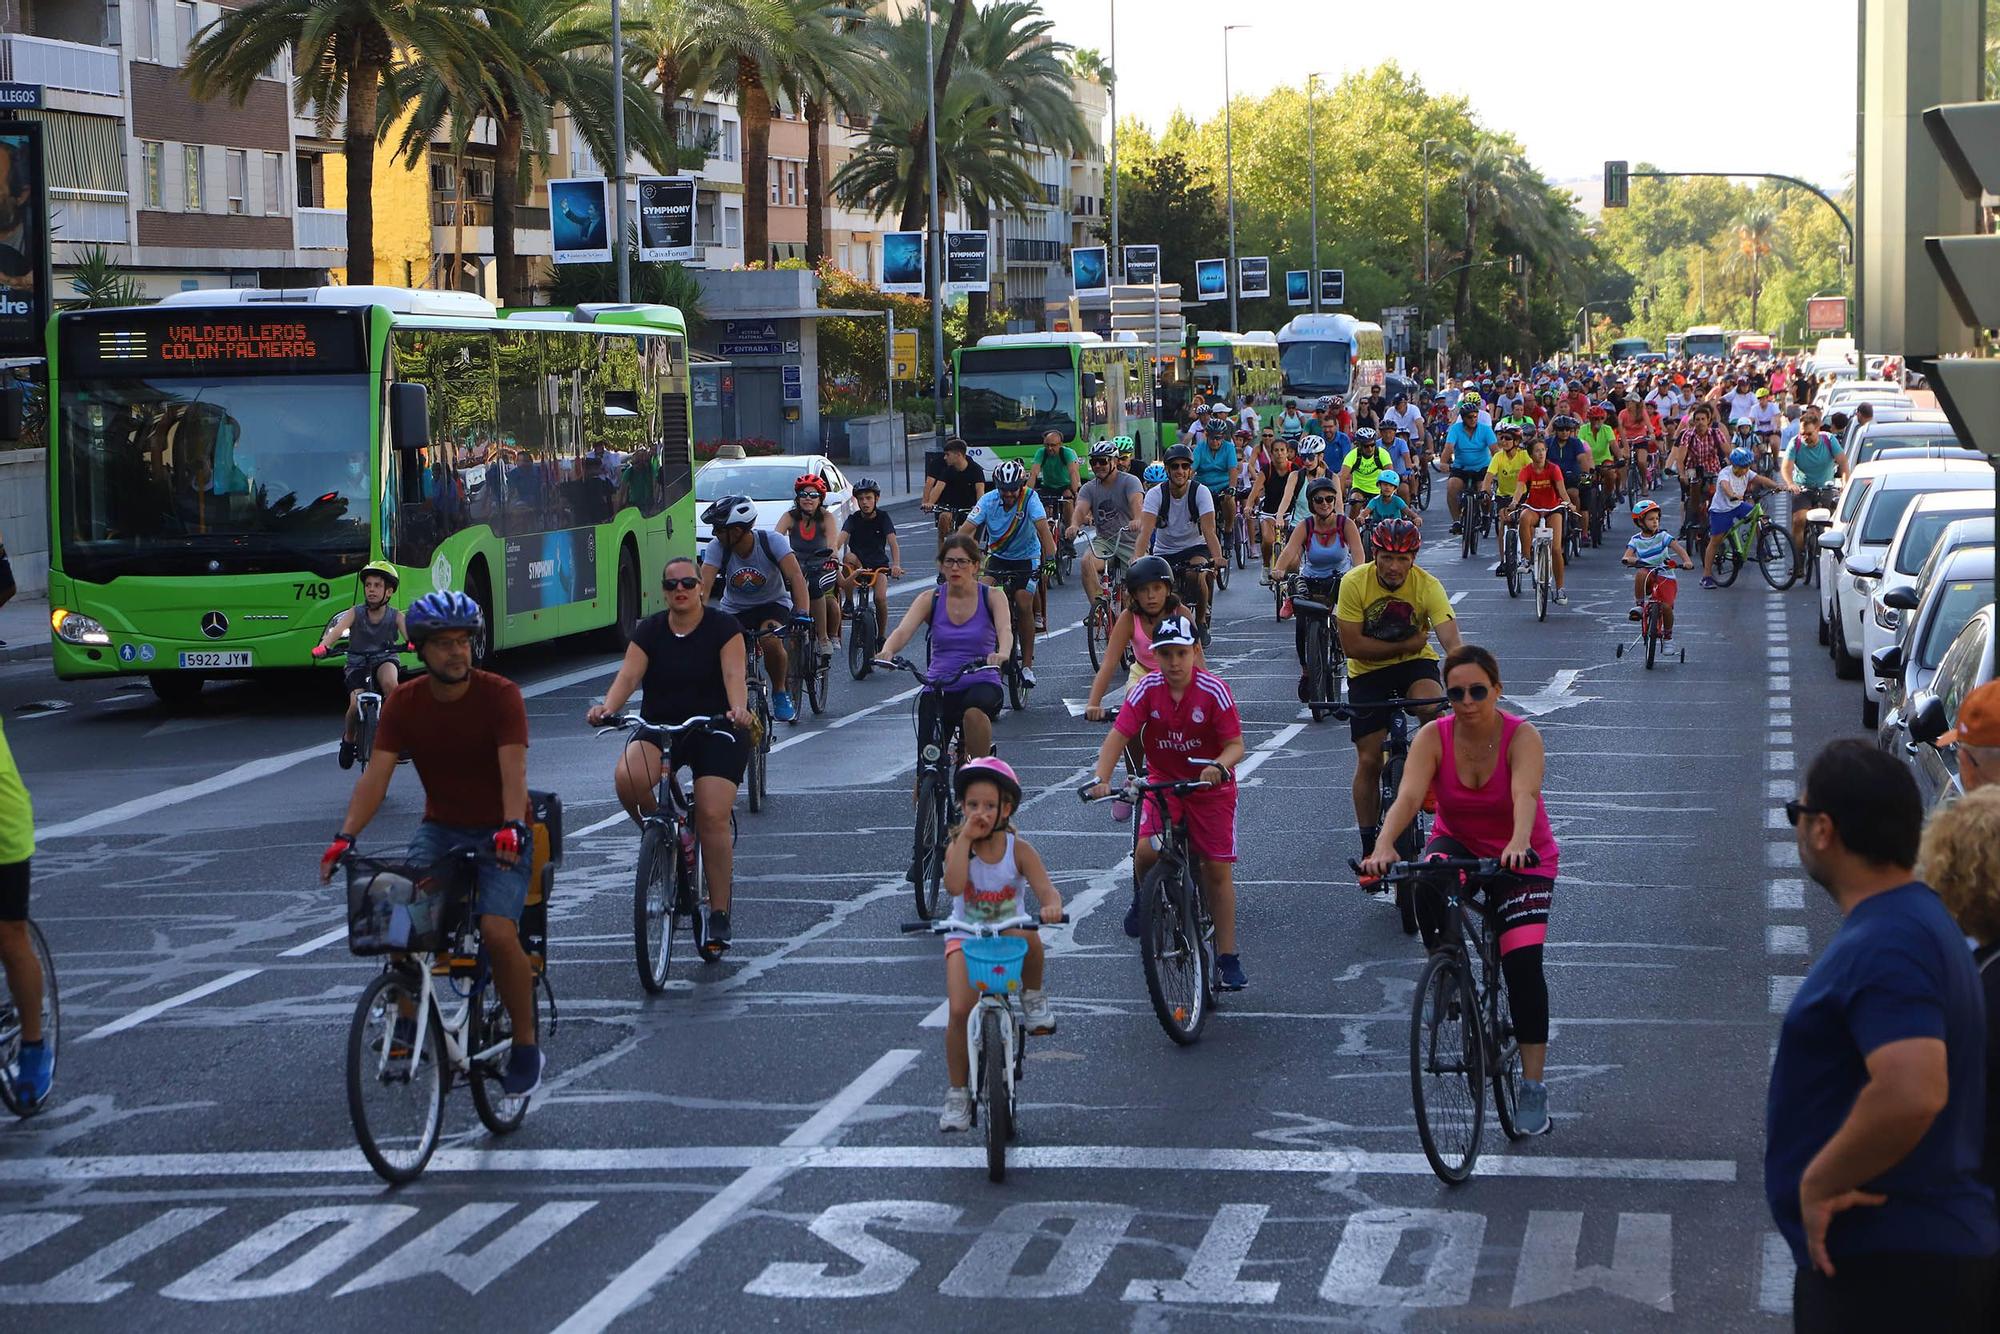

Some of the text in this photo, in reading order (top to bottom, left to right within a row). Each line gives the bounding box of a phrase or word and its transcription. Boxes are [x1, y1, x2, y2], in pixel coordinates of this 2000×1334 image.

[643, 206, 691, 215] SYMPHONY
[648, 250, 688, 258] CaixaForum
[169, 324, 307, 342] VALDEOLLEROS
[727, 323, 736, 333] P
[160, 341, 316, 360] COLON-PALMERAS
[734, 345, 769, 353] ENTRADA
[897, 363, 907, 377] P
[528, 559, 555, 580] SYMPHONY
[293, 583, 330, 601] 749
[187, 653, 249, 667] 5922 JYW
[744, 1199, 1673, 1312] MOTOS
